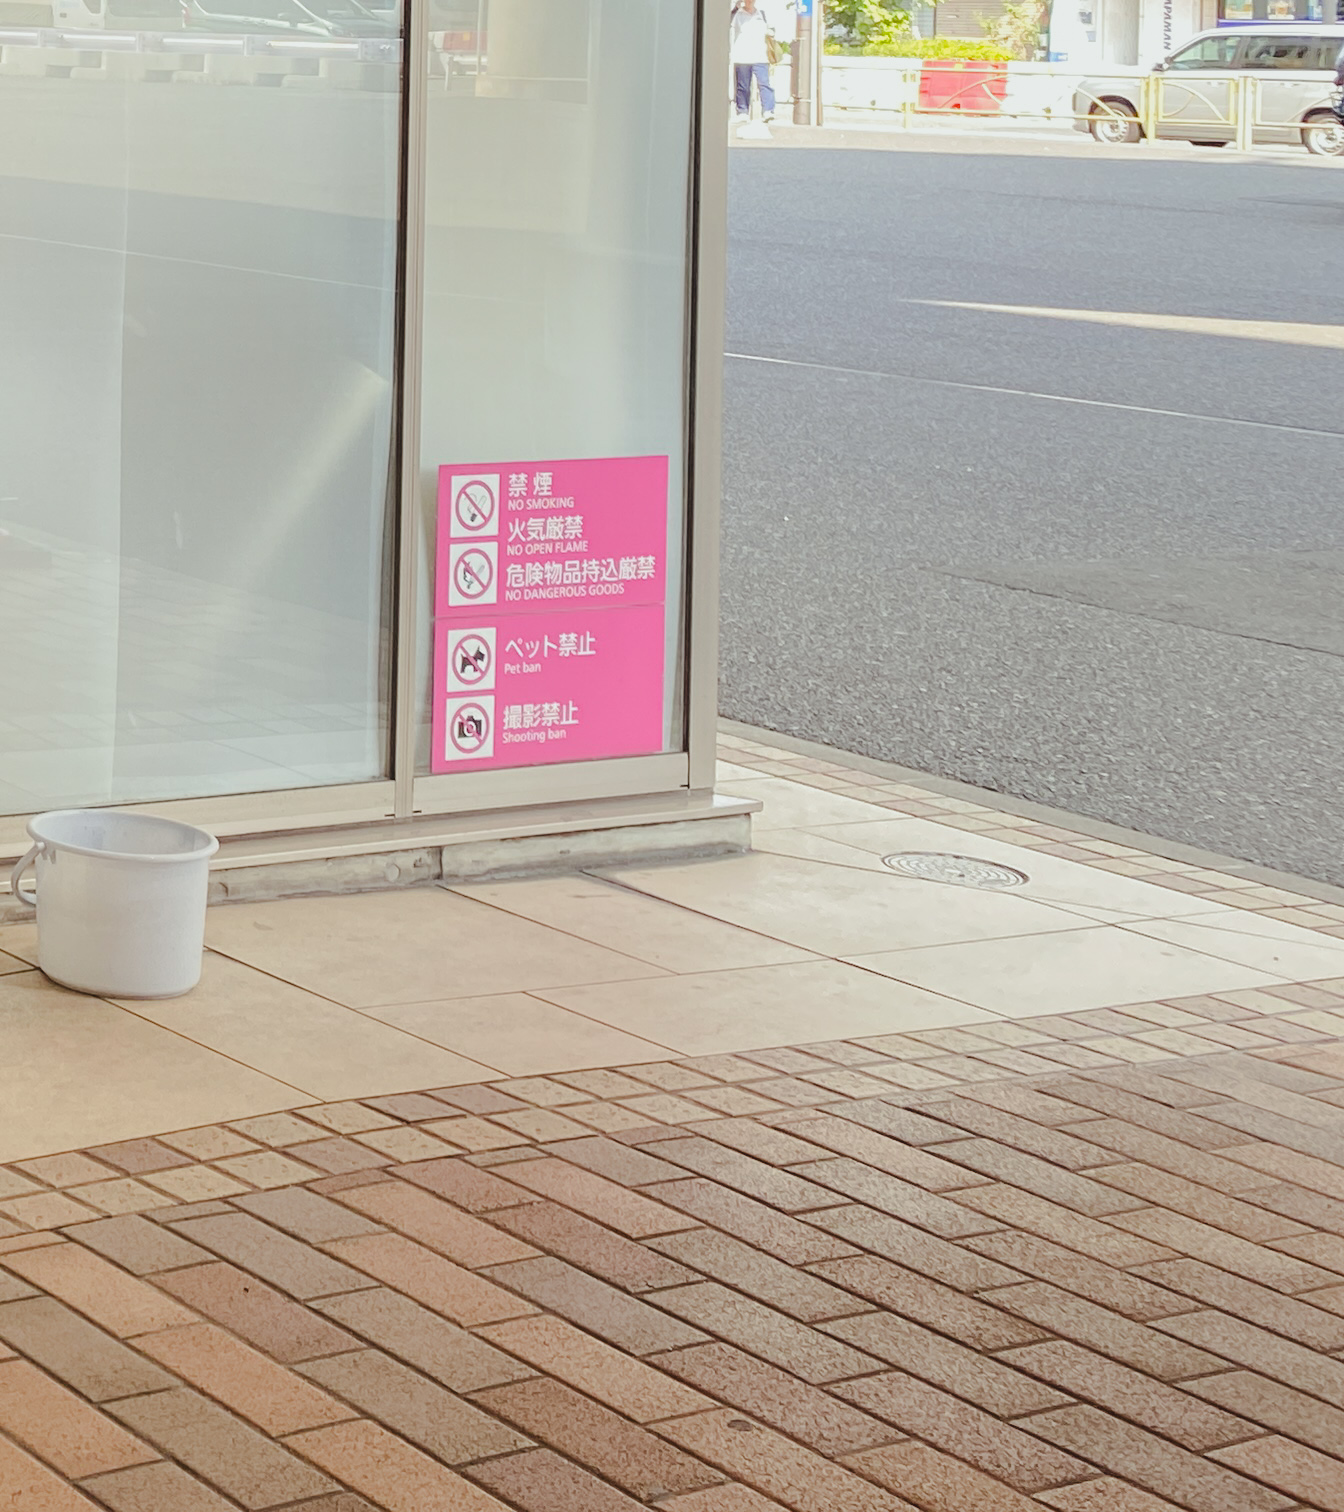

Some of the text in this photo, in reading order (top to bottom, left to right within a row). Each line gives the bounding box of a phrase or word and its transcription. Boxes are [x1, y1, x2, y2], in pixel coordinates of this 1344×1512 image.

[508, 472, 553, 497] 禁煙
[508, 497, 574, 511] NO SMOKING
[507, 516, 583, 542] 火気厳禁
[506, 541, 588, 556] NO OPEN FLAME
[506, 555, 655, 588] 危険物品持込厳禁
[505, 583, 624, 601] NO DANGEROUS GOODS
[504, 631, 596, 658] ペット禁止
[504, 661, 541, 675] Pet ban
[503, 701, 579, 730] 撮影禁止
[502, 728, 566, 744] Shooting ban
